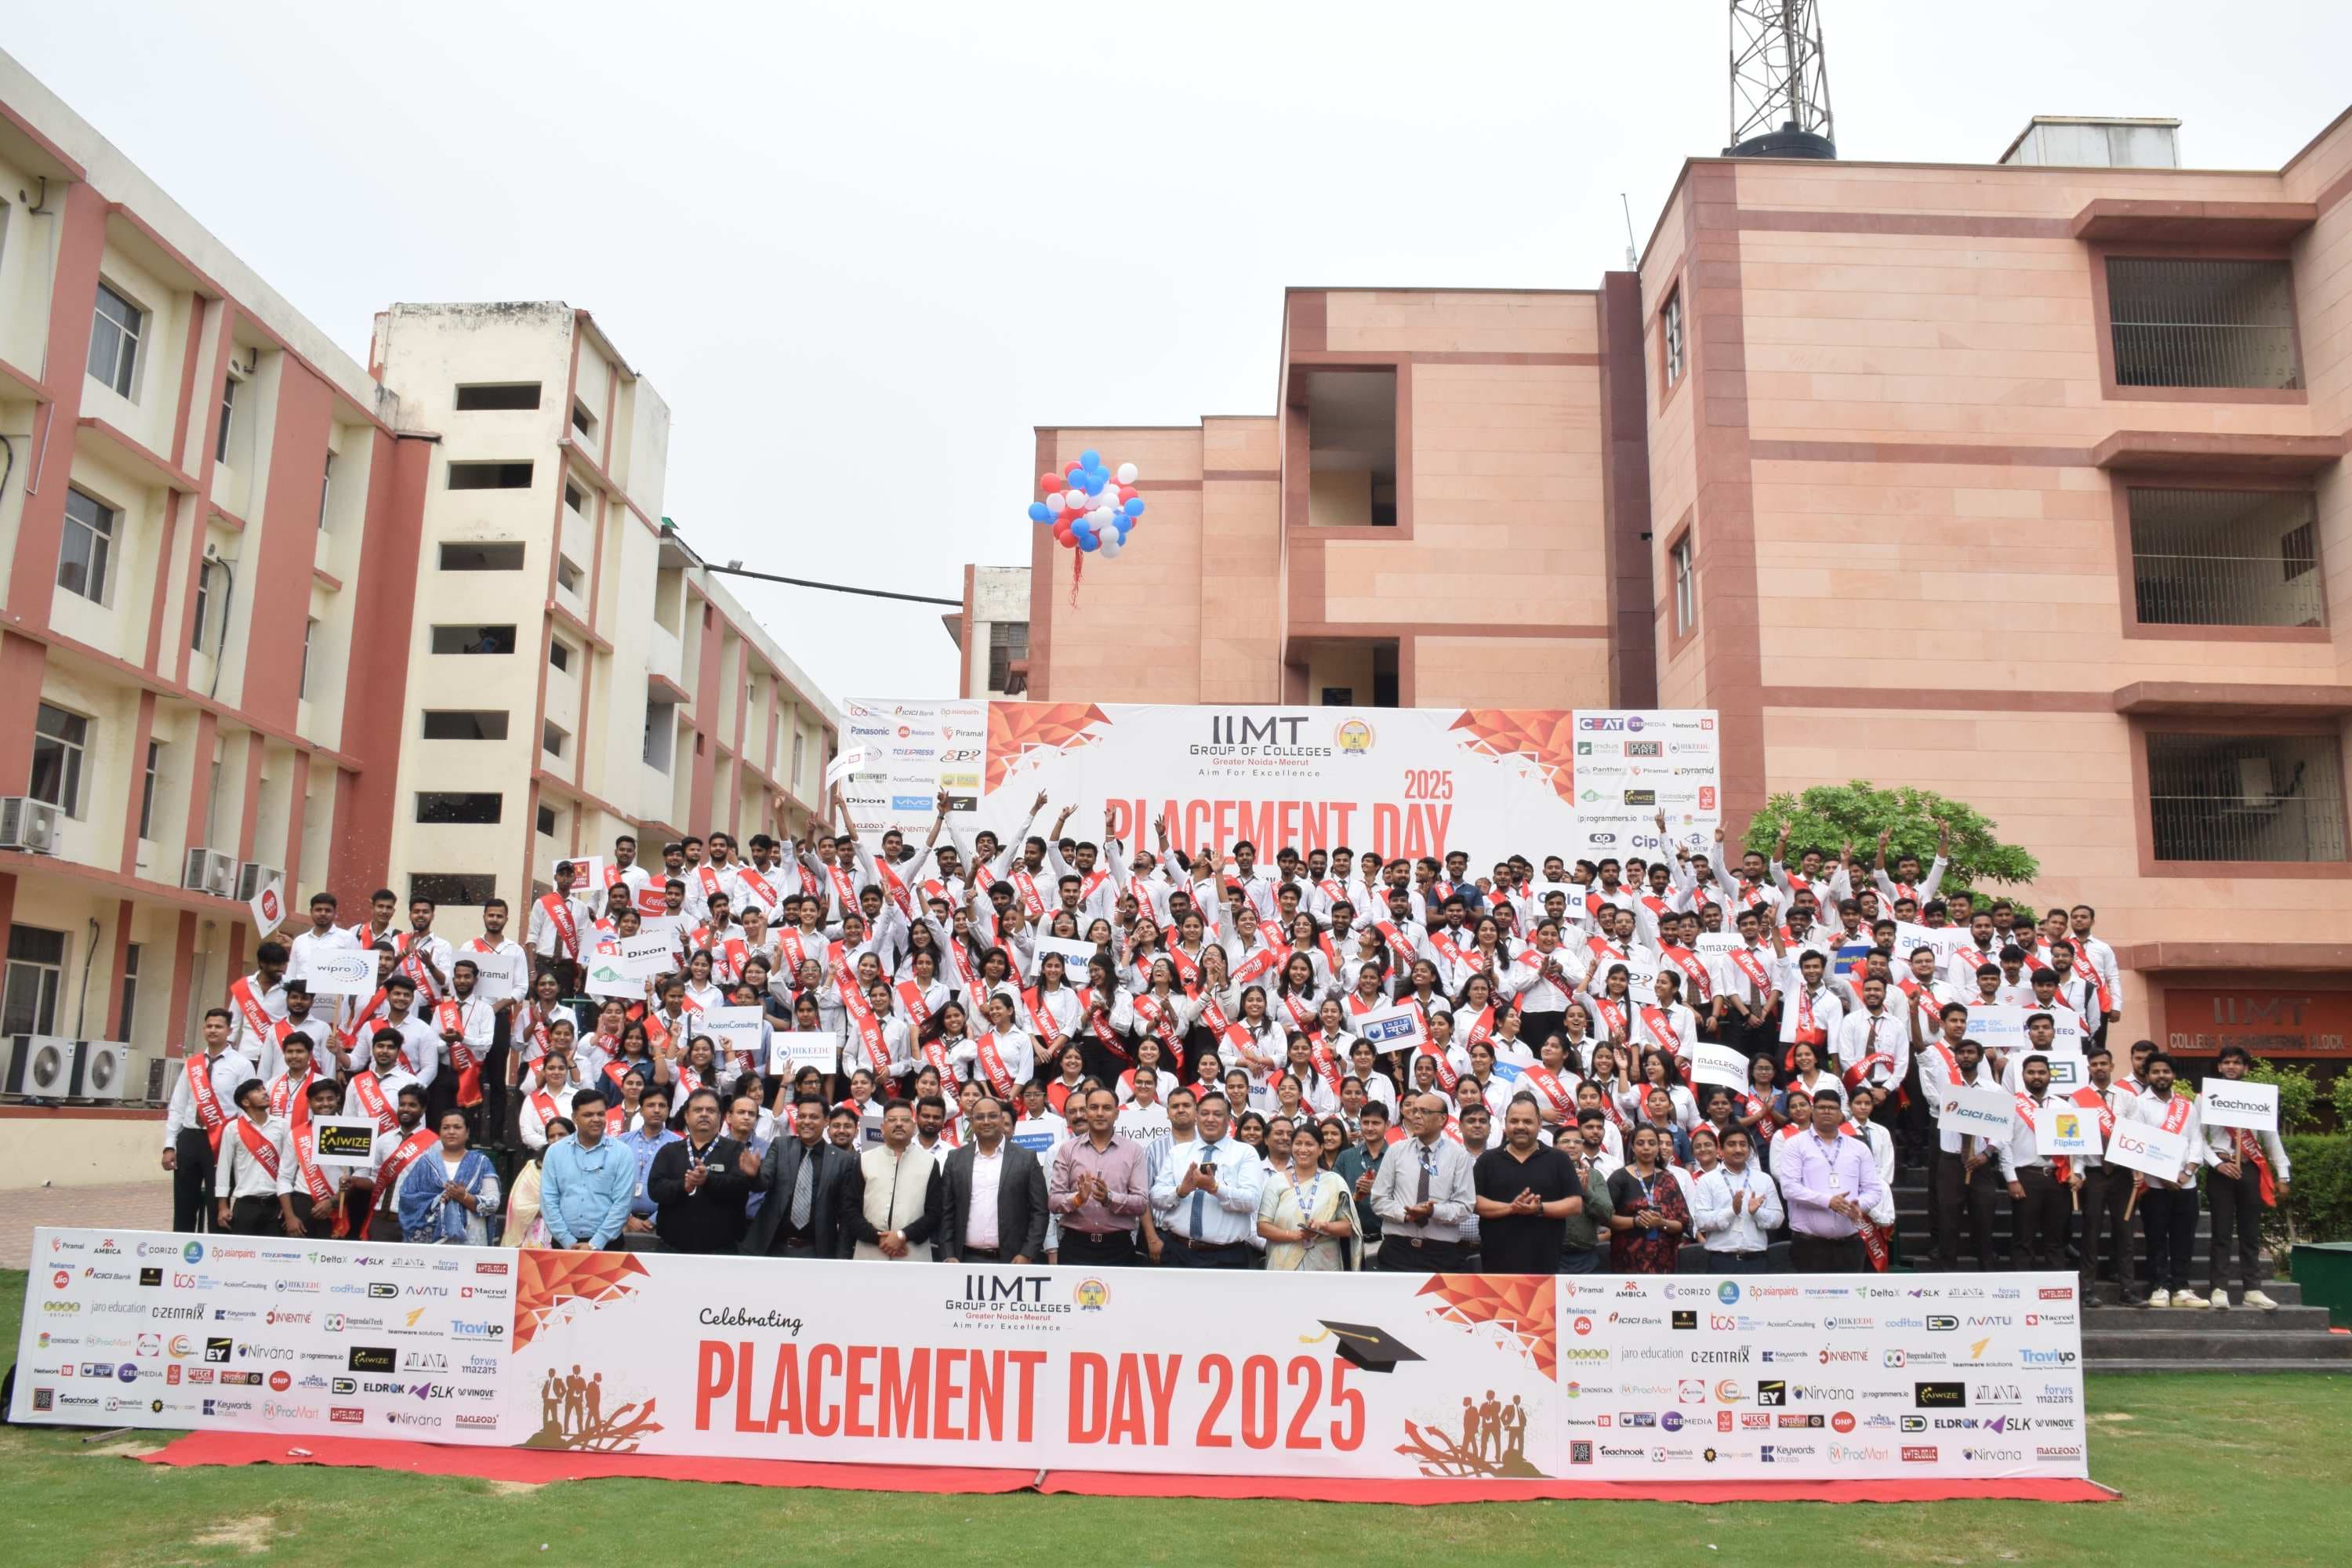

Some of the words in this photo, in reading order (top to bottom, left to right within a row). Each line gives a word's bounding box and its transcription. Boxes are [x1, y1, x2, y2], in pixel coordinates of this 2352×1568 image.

[1213, 716, 1308, 745] IIMT
[1581, 719, 1624, 730] CEAT
[1702, 720, 1712, 728] 18
[851, 727, 889, 735] Panasonic
[1190, 745, 1235, 755] GROUP
[1242, 746, 1258, 755] OF
[1264, 746, 1331, 757] COLLEGES
[1404, 769, 1453, 800] 2025
[1373, 803, 1453, 866] DAY
[1028, 895, 1042, 912] IIMT
[628, 946, 666, 958] Dixon
[477, 969, 509, 979] iramal
[2213, 997, 2311, 1025] IIMT
[708, 1021, 759, 1029] AcxiomConsulting
[1383, 1018, 1408, 1027] INDIA
[1167, 1036, 1184, 1053] IIMT
[2170, 1033, 2216, 1049] COLLEGE
[2310, 1034, 2345, 1050] BLOCK
[865, 1029, 887, 1068] #PlacedBy
[454, 1047, 472, 1069] IIMT
[982, 1046, 1004, 1083] #PlacedBy
[1697, 1057, 1744, 1074] MACLEODS
[191, 1065, 211, 1105] #PlacedBy
[202, 1104, 223, 1127] IIMT
[2209, 1094, 2270, 1112] Teachnook
[1957, 1108, 1983, 1119] ICICI
[1984, 1113, 2009, 1124] Bank
[327, 1137, 370, 1148] AIWIZE
[2119, 1133, 2145, 1153] tcs
[2241, 1138, 2260, 1159] IIMT
[321, 1254, 347, 1264] DeltaX
[53, 1274, 69, 1284] Jio
[966, 1275, 1051, 1302] IIMT
[1763, 1287, 1798, 1297] asianpaints
[90, 1301, 107, 1314] jaro
[108, 1301, 146, 1313] education
[946, 1300, 985, 1311] GROUP
[1011, 1302, 1071, 1312] COLLEGES
[699, 1308, 804, 1337] Celebrating
[1575, 1321, 1590, 1330] Jio
[1711, 1312, 1735, 1330] tcs
[1767, 1320, 1816, 1329] AcxiomConsulting
[1886, 1318, 1923, 1327] coditas
[1967, 1316, 2011, 1325] AVATU
[451, 1320, 503, 1338] Traviyo
[206, 1348, 227, 1361] EY
[248, 1344, 294, 1360] Nirvana
[1621, 1346, 1639, 1361] jaro
[1640, 1345, 1683, 1359] education
[1691, 1345, 1751, 1363] C-ZENTRIX
[1830, 1352, 1868, 1361] INVENTIVE
[2020, 1348, 2075, 1365] Traviyo
[470, 1355, 497, 1367] forvis
[63, 1367, 72, 1375] 18
[462, 1365, 496, 1374] mazars
[430, 1385, 454, 1399] SLK
[1804, 1385, 1854, 1400] Nirvana
[1976, 1385, 2022, 1399] ATLANTA
[2045, 1384, 2073, 1394] forvis
[695, 1340, 1047, 1443] PLACEMENT
[1068, 1352, 1183, 1446] DAY
[1196, 1352, 1366, 1452] 2025
[1759, 1392, 1780, 1405] EY
[217, 1399, 252, 1411] Keywords
[397, 1413, 441, 1427] Nirvana
[456, 1415, 497, 1425] MACLEODS
[1599, 1417, 1610, 1426] 18
[2006, 1417, 2032, 1430] SLK
[1573, 1451, 1589, 1461] FIRE
[1777, 1446, 1815, 1455] Keywords
[1843, 1446, 1888, 1461] ProcMart
[1975, 1448, 2022, 1461] Nirvana
